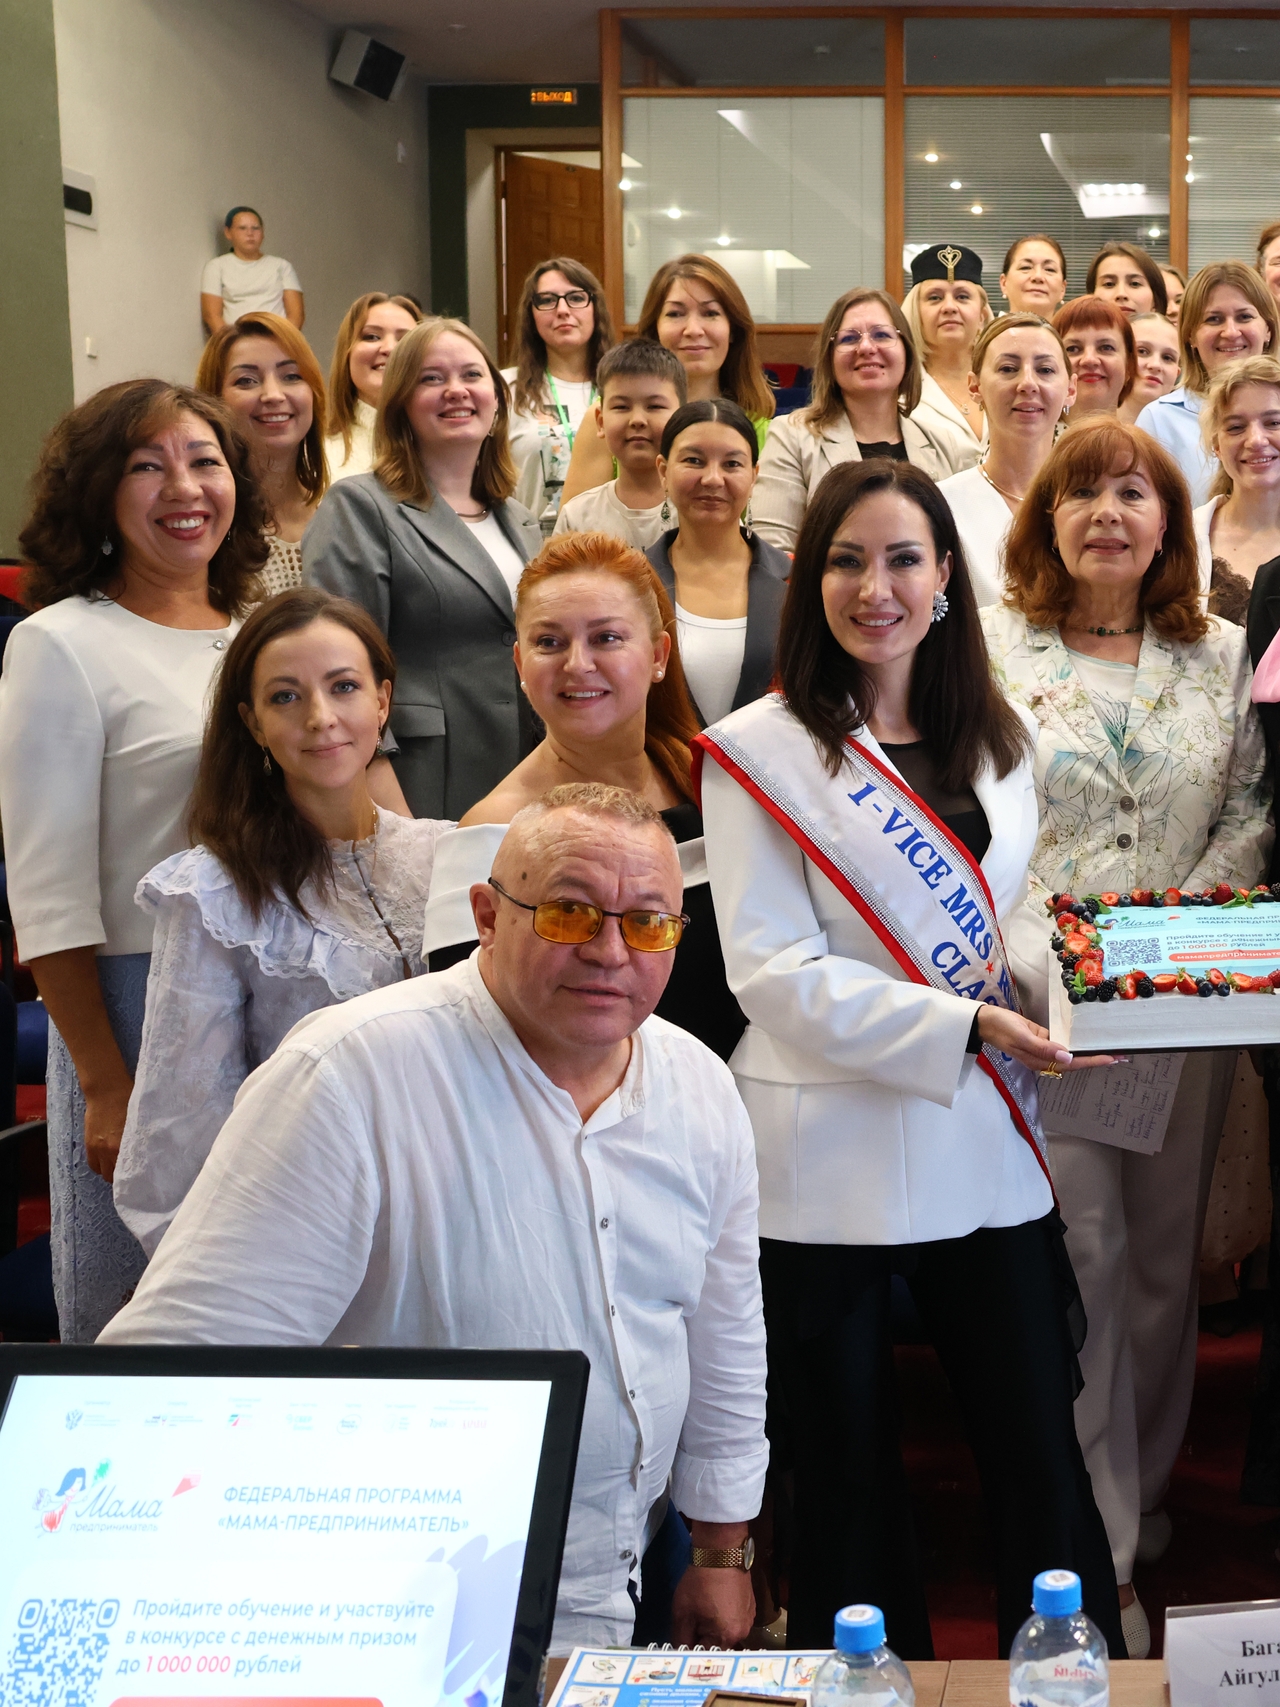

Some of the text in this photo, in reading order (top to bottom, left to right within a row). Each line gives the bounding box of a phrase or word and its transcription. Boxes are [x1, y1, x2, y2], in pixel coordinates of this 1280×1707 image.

[536, 91, 573, 103] ВЫХОД
[940, 882, 993, 961] MRS
[1119, 919, 1166, 928] Мама
[1166, 933, 1215, 941] Пройдите
[75, 1484, 163, 1518] Мама
[224, 1486, 463, 1505] ФЕДЕРАЛЬНАЯ ПРОГРАММА
[70, 1523, 158, 1533] предприниматель
[218, 1514, 469, 1534] «МАМА-ПРЕДПРИНИМАТЕЛЬ»
[133, 1597, 435, 1622] Пройдите обучение и участвуйте
[125, 1630, 417, 1650] в конкурсе с денежным призом
[115, 1658, 141, 1675] до
[157, 1655, 191, 1673] 000
[196, 1655, 231, 1673] 000
[234, 1655, 302, 1677] рублей
